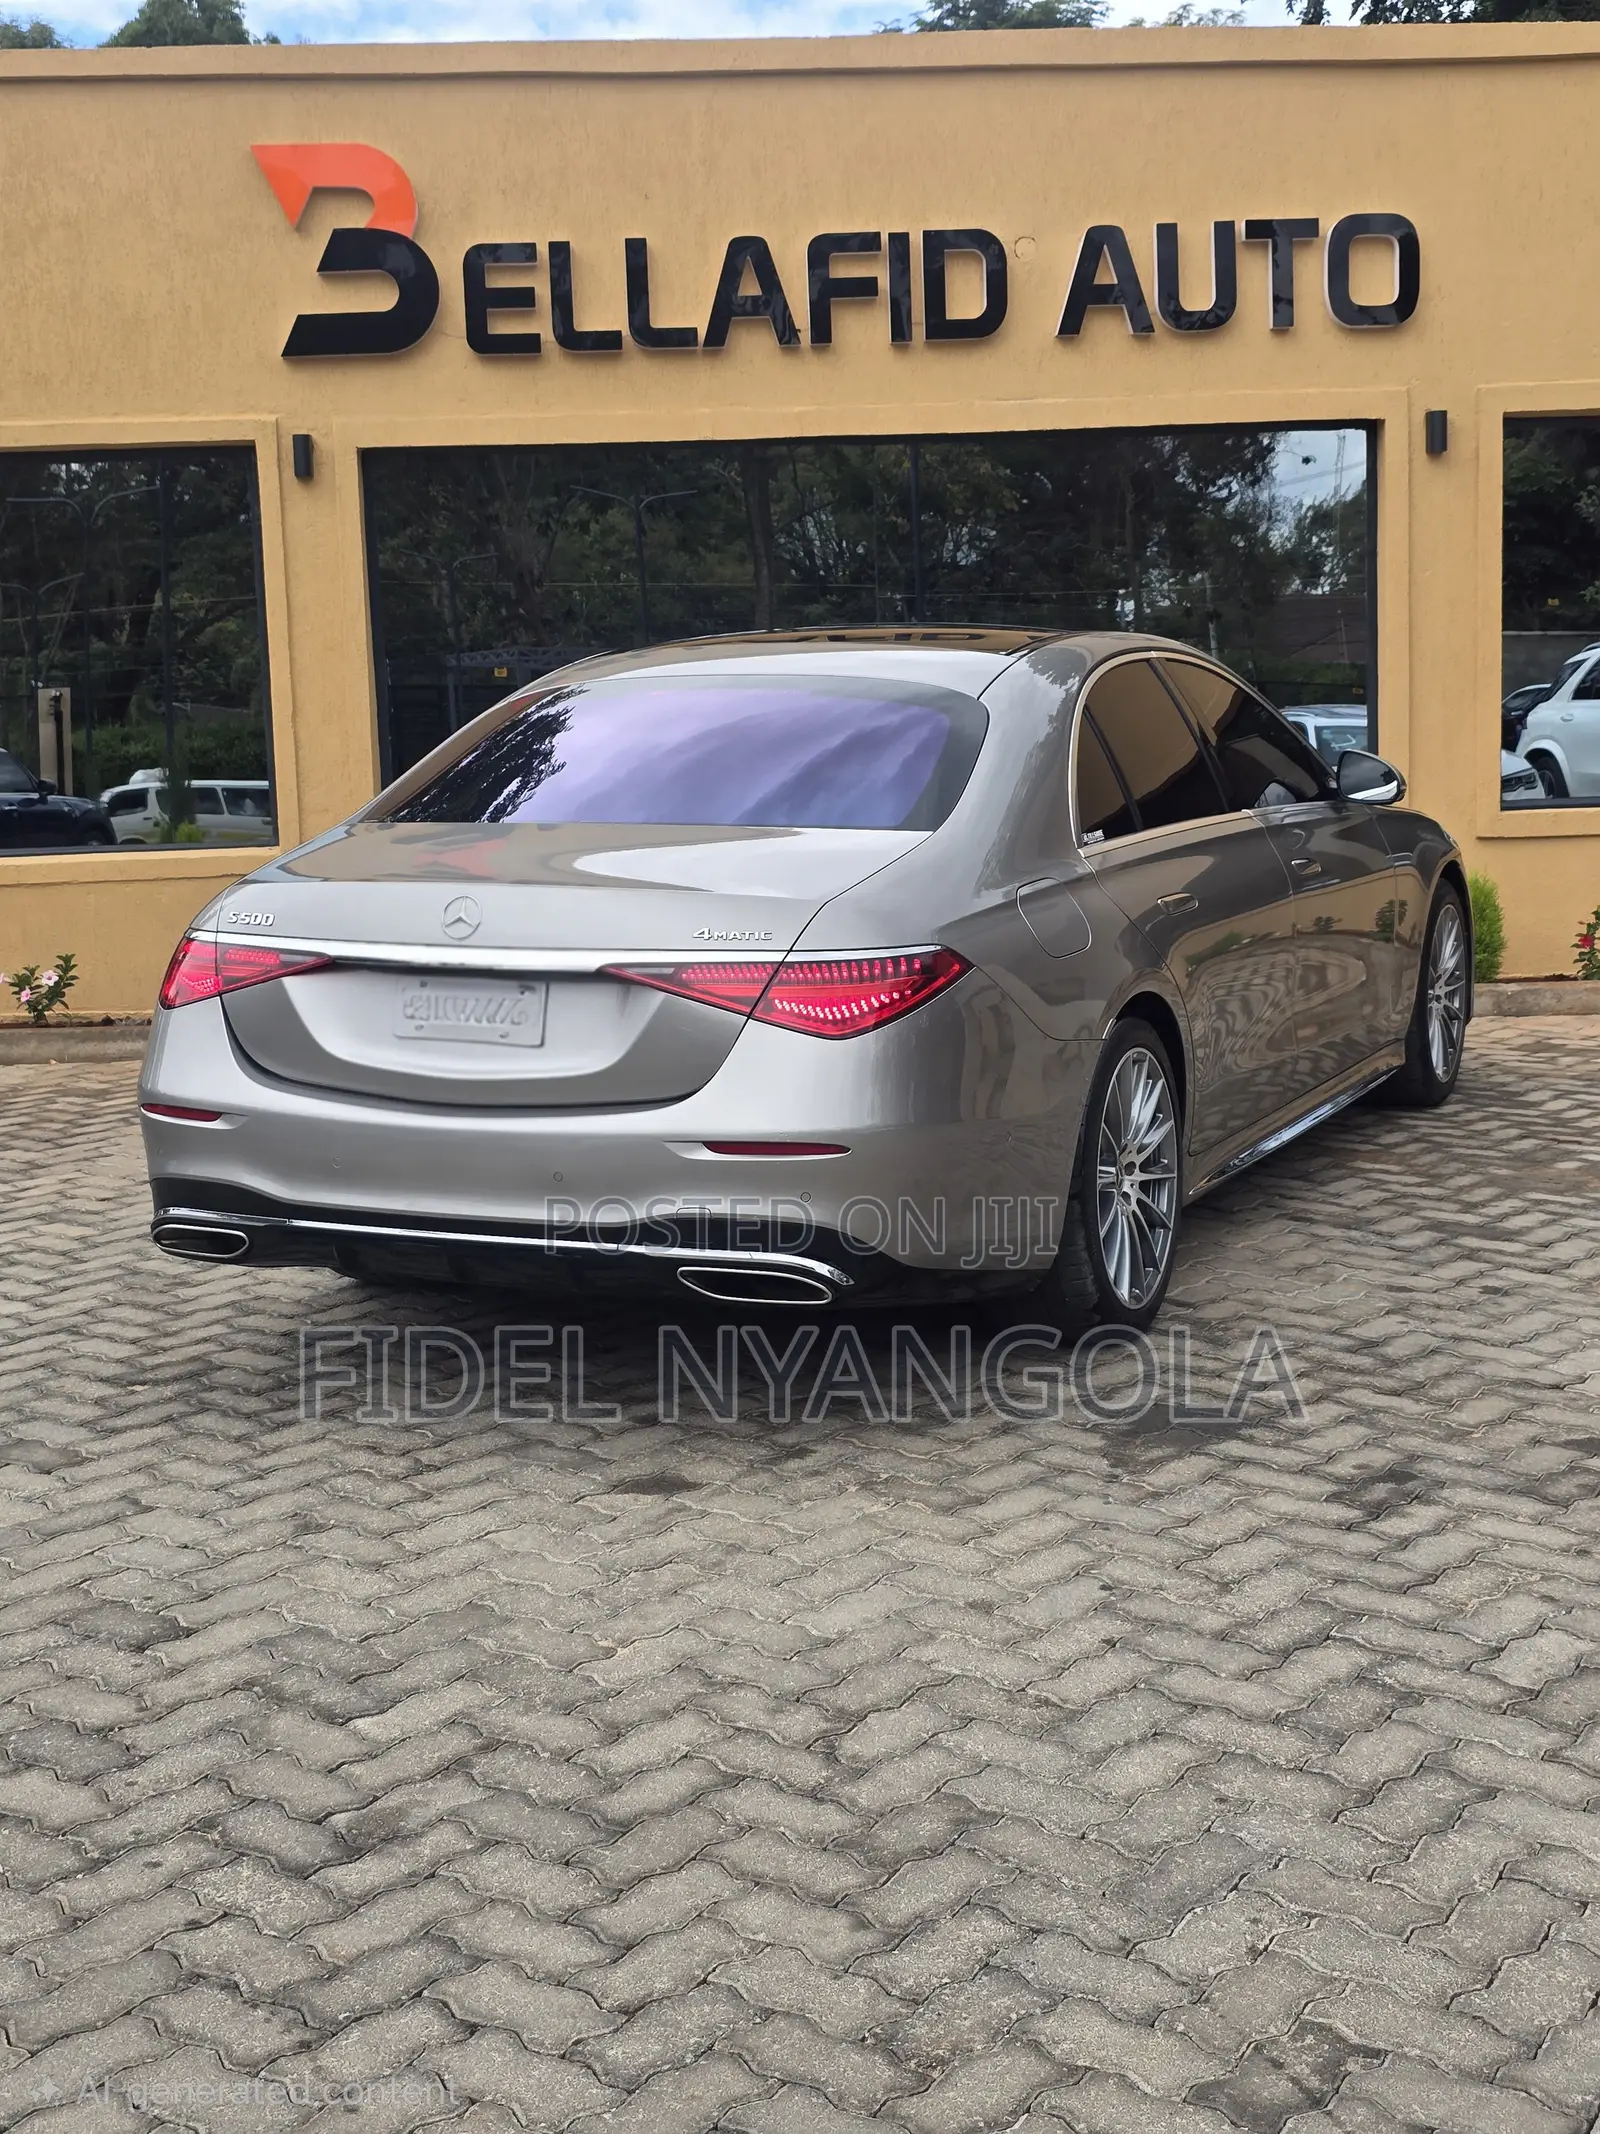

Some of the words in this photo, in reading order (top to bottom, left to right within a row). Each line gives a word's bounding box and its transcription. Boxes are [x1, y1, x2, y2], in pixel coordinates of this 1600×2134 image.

[250, 143, 1008, 359] BELLAFID
[1055, 213, 1421, 338] AUTO
[226, 911, 276, 927] S500
[692, 927, 773, 941] 4MATIC
